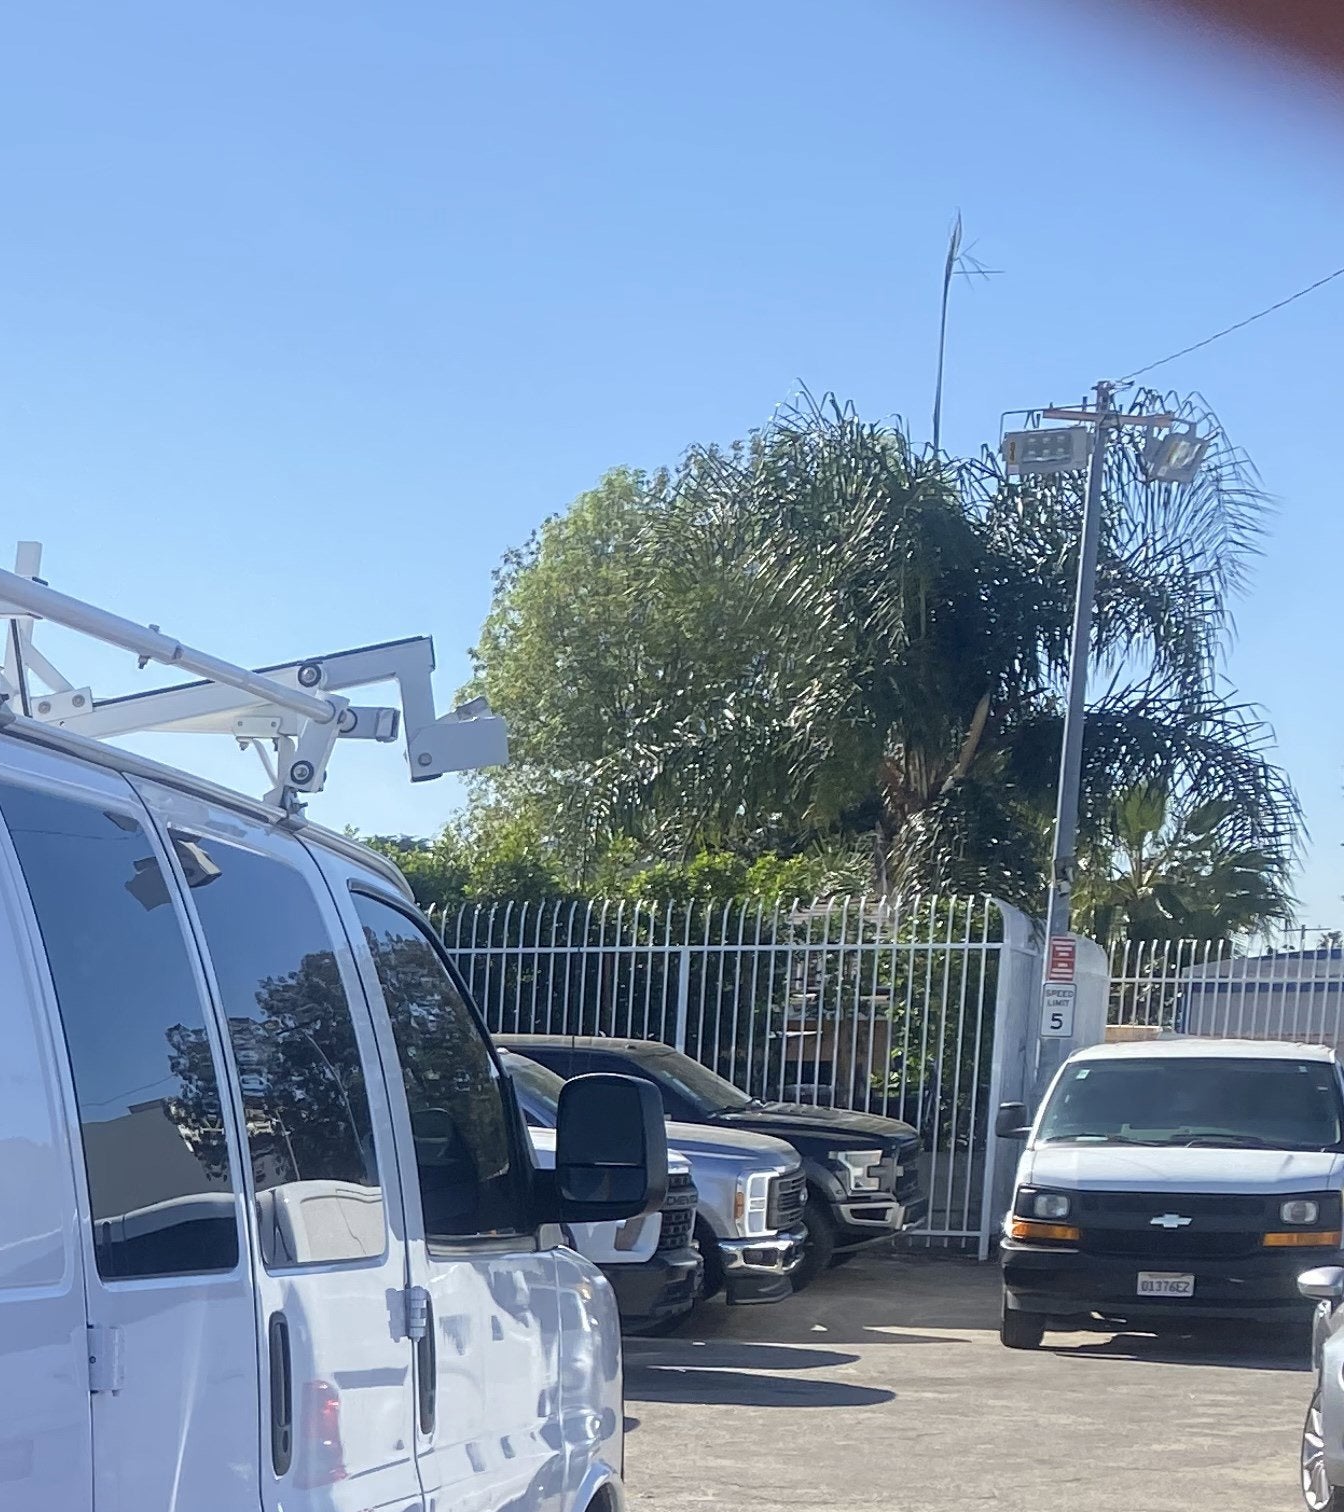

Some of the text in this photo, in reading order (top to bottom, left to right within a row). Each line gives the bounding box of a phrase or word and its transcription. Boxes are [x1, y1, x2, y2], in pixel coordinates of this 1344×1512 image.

[1045, 989, 1074, 998] SPEED
[1046, 999, 1070, 1007] LIMIT
[1050, 1012, 1063, 1030] 5
